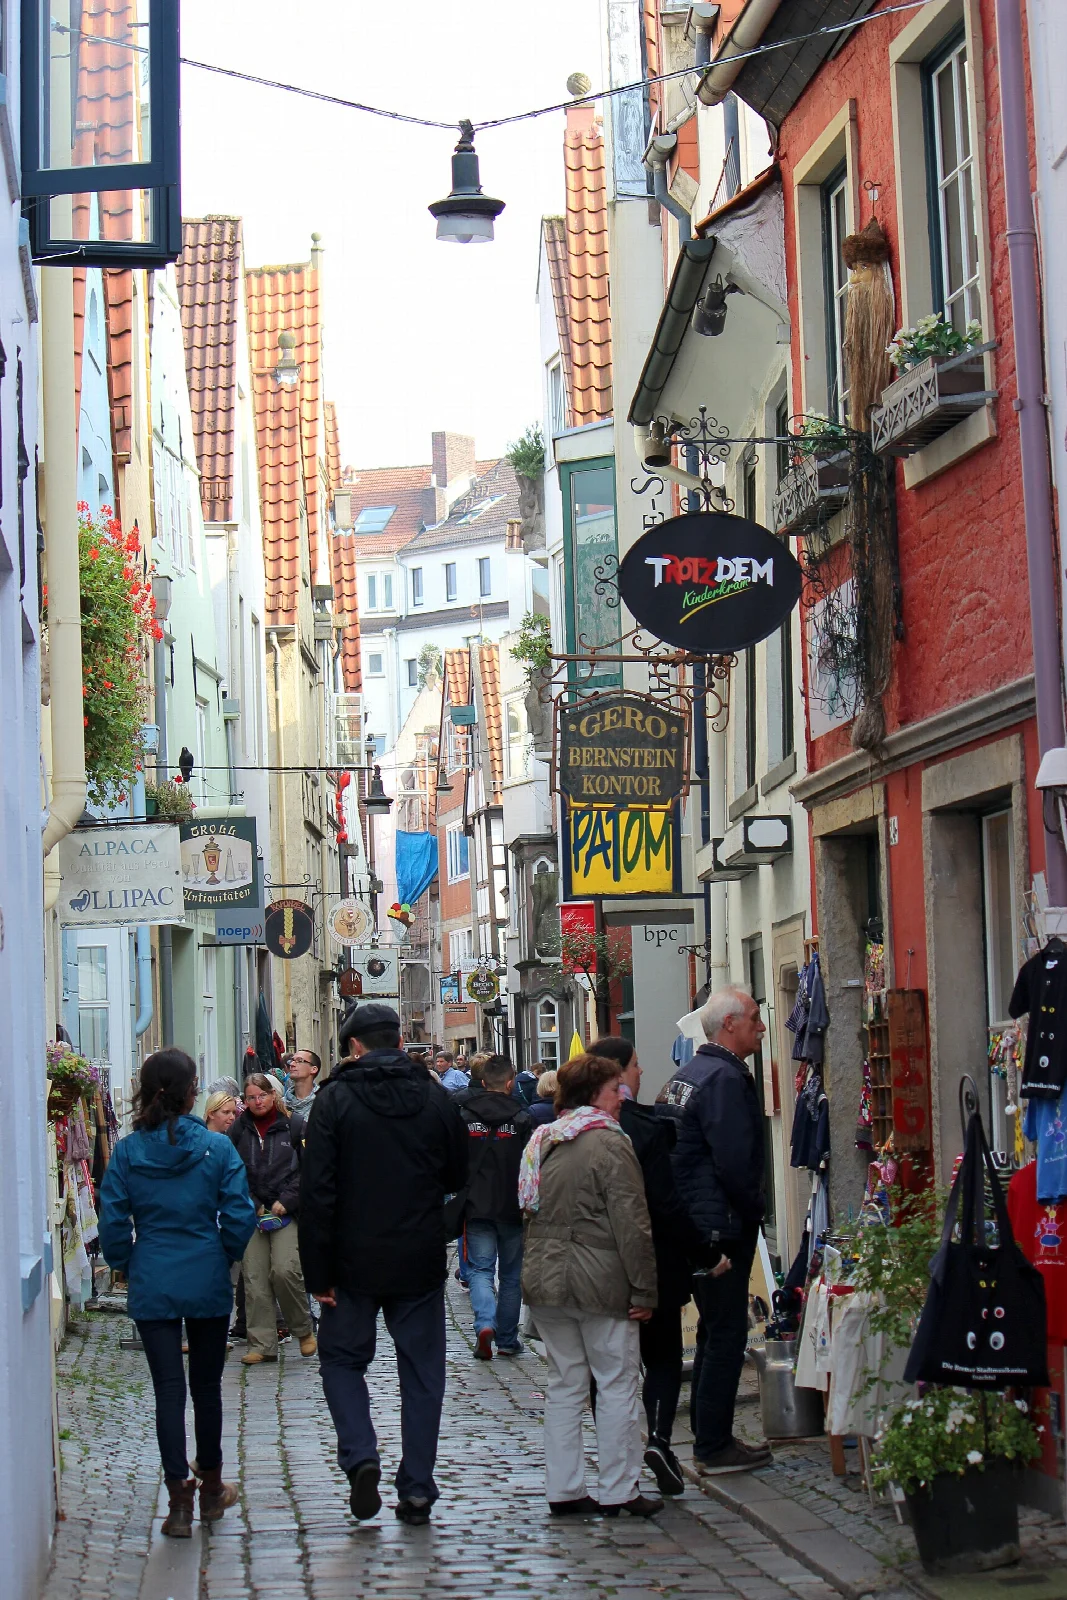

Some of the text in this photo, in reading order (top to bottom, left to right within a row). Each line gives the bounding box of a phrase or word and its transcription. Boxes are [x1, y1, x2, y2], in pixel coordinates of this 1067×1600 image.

[644, 554, 774, 588] TROTZDEM
[682, 577, 749, 609] Kinderkram
[579, 705, 667, 740] GERO
[568, 746, 677, 768] BERNSTEIN
[582, 774, 661, 796] KONTOR
[78, 839, 159, 857] ALPACA
[572, 804, 671, 882] PATOM
[69, 859, 171, 875] Qualität aus Peru
[110, 874, 132, 884] von
[183, 887, 251, 905] Antiquitäten
[270, 900, 306, 912] RAPUNZEL
[217, 926, 251, 939] noep
[643, 926, 678, 947] bpc
[941, 1361, 954, 1371] Die
